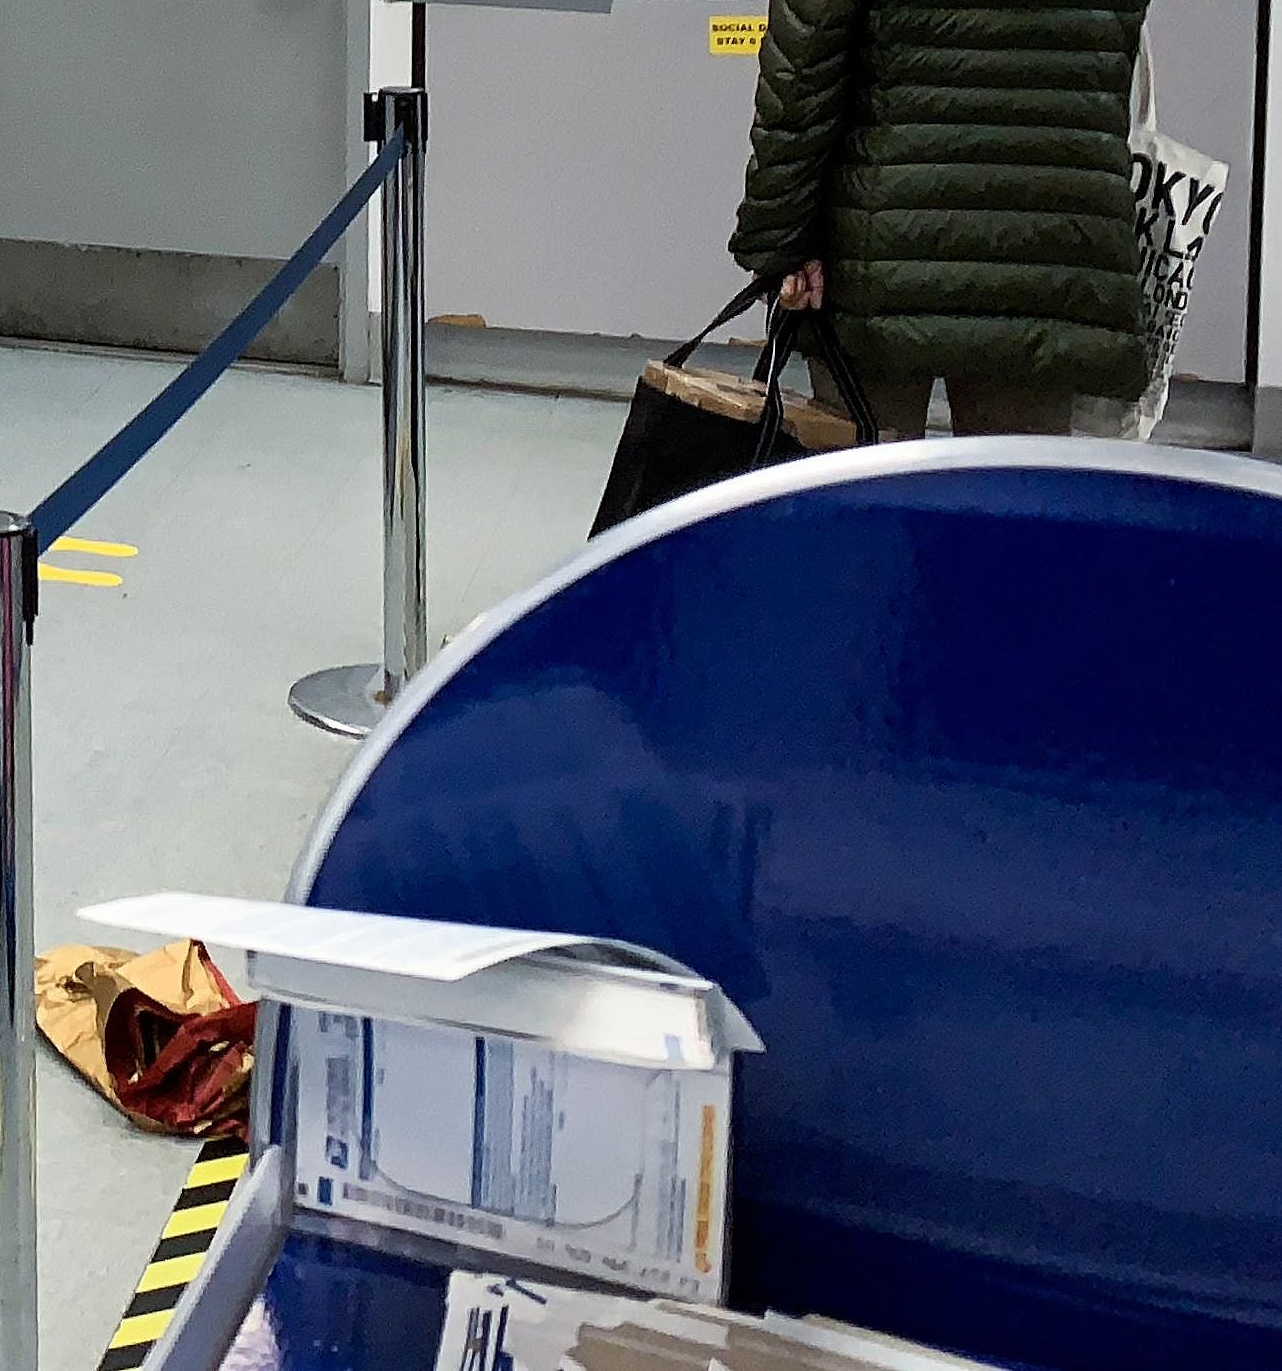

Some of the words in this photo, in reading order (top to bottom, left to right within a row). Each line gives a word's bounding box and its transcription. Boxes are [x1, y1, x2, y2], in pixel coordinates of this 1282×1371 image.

[711, 23, 754, 33] SOCIAL
[716, 36, 745, 45] STAY
[1130, 152, 1224, 235] OKY
